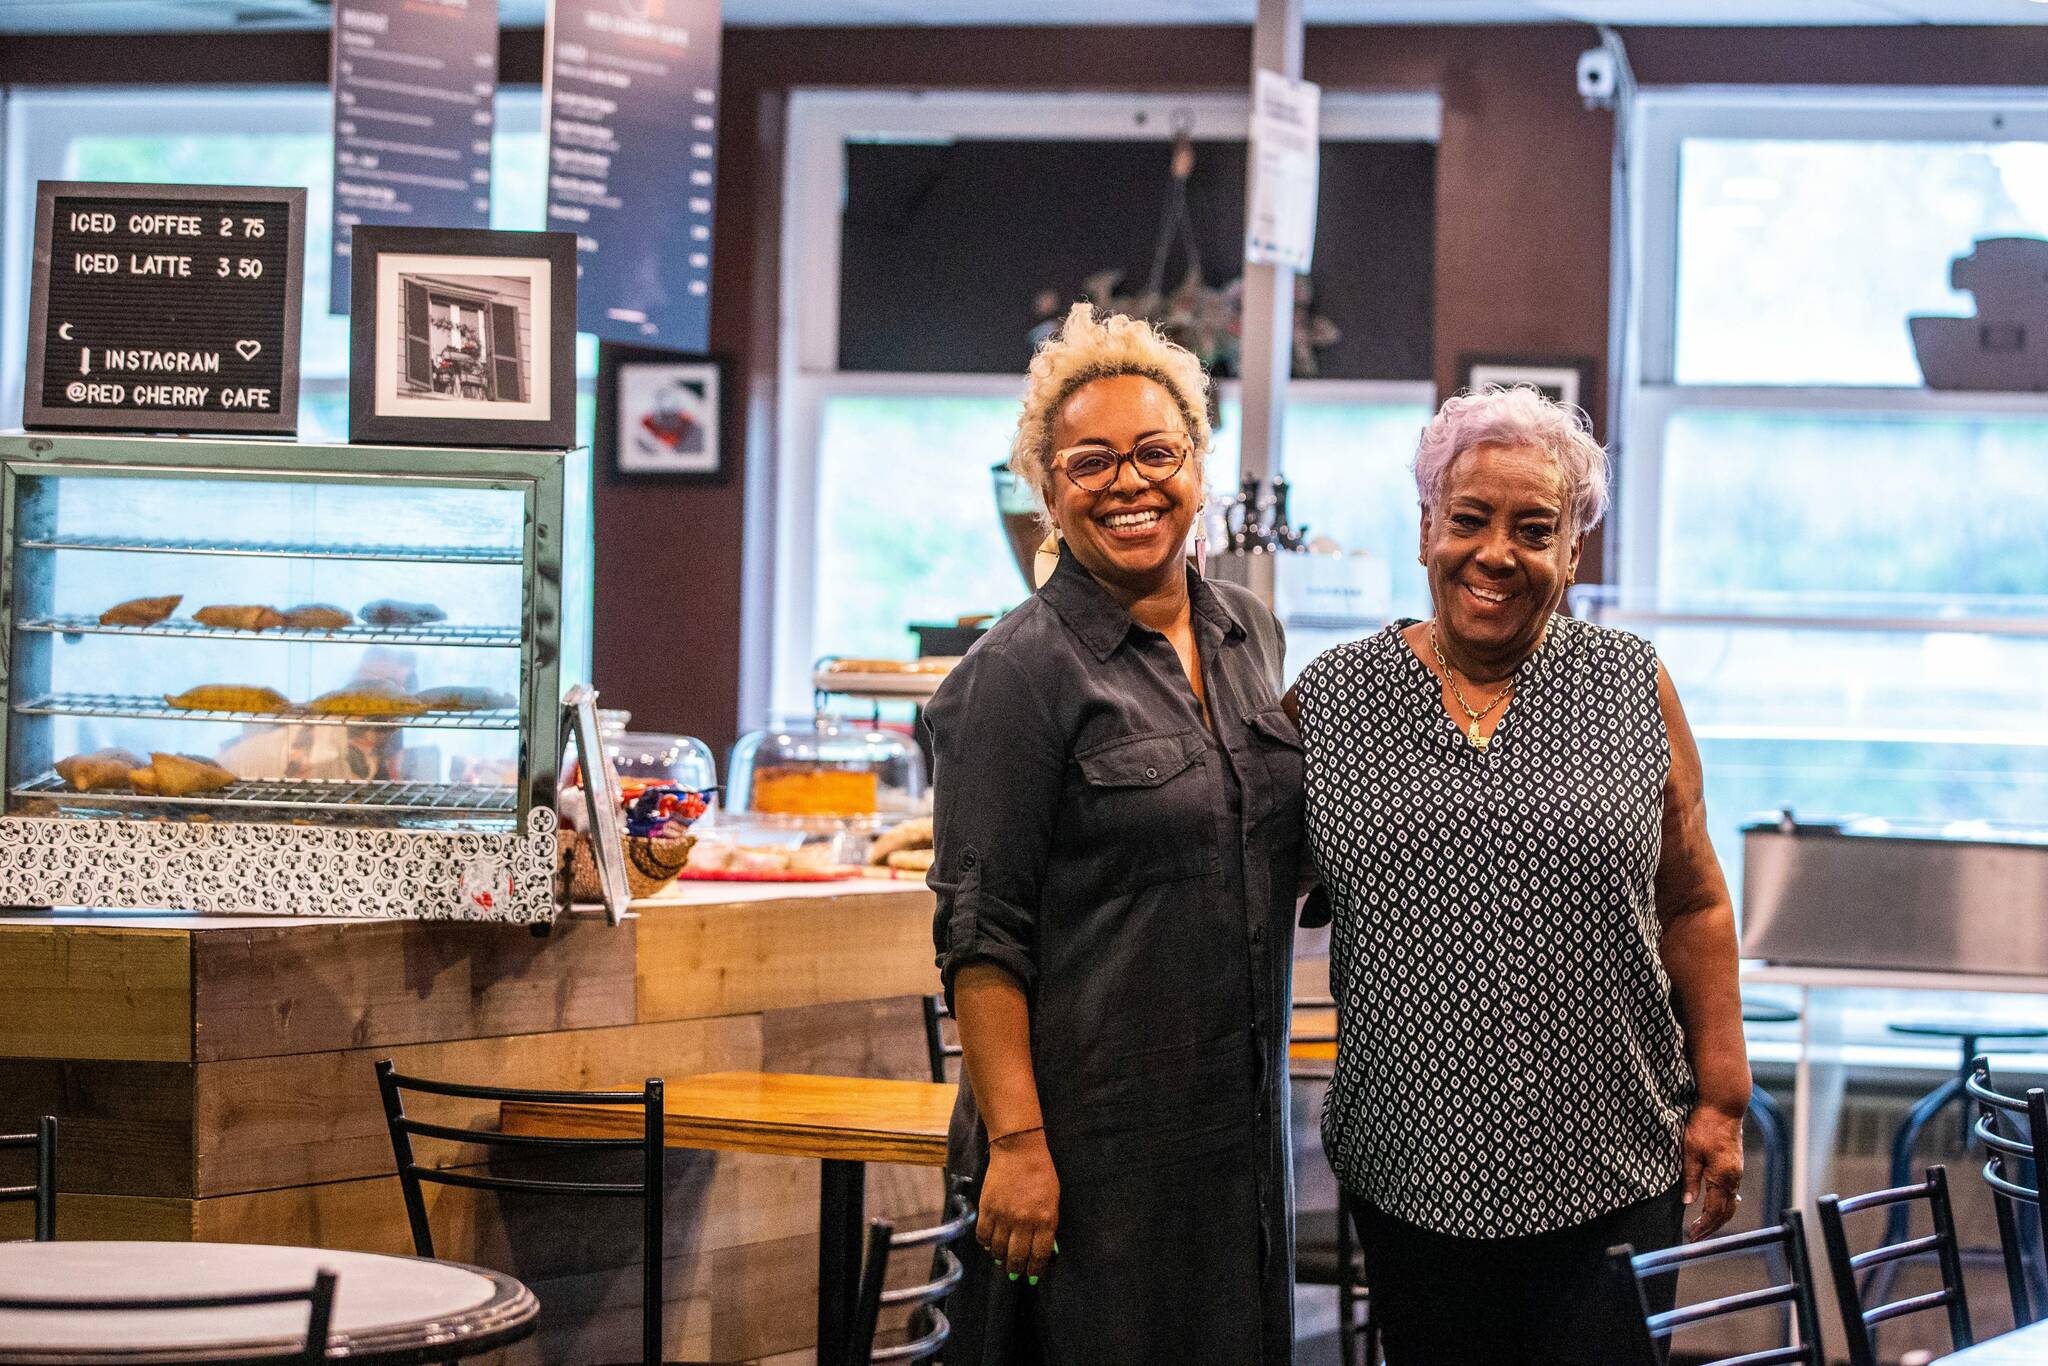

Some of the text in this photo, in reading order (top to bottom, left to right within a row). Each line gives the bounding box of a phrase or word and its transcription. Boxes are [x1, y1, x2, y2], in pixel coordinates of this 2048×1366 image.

[70, 212, 265, 238] ICED COFFEE 2 75
[75, 253, 263, 280] ICED LATTE 3 50
[105, 349, 220, 373] INSTAGRAM
[66, 381, 271, 409] @RED CHERRY CAFE
